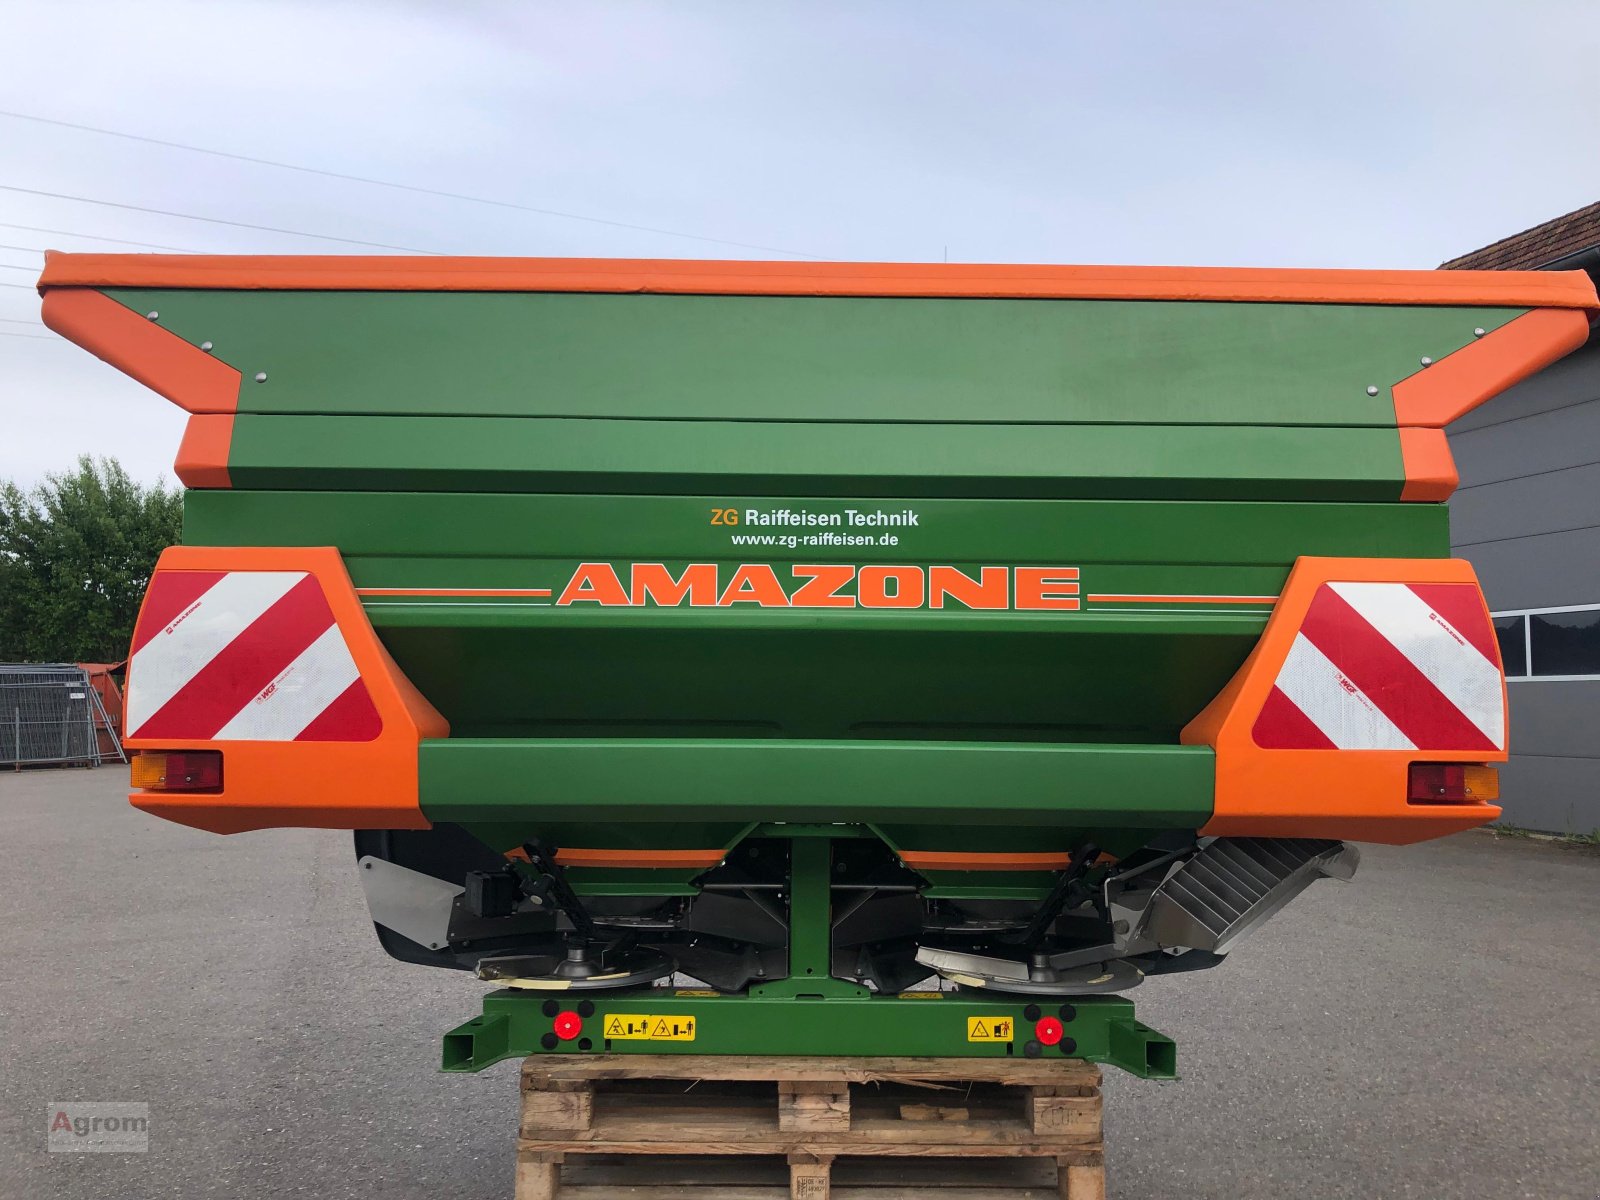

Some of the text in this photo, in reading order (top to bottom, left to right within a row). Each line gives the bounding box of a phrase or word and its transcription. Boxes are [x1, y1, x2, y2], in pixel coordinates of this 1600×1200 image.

[710, 508, 919, 526] ZG Raiffeisen Technik
[731, 532, 899, 548] www.zg-raiffeisen.de
[555, 562, 1081, 611] AMAZONE
[173, 601, 202, 628] AMAZONE
[1436, 619, 1465, 646] AMAZONE
[261, 682, 276, 699] WGF
[1340, 678, 1357, 694] WGF
